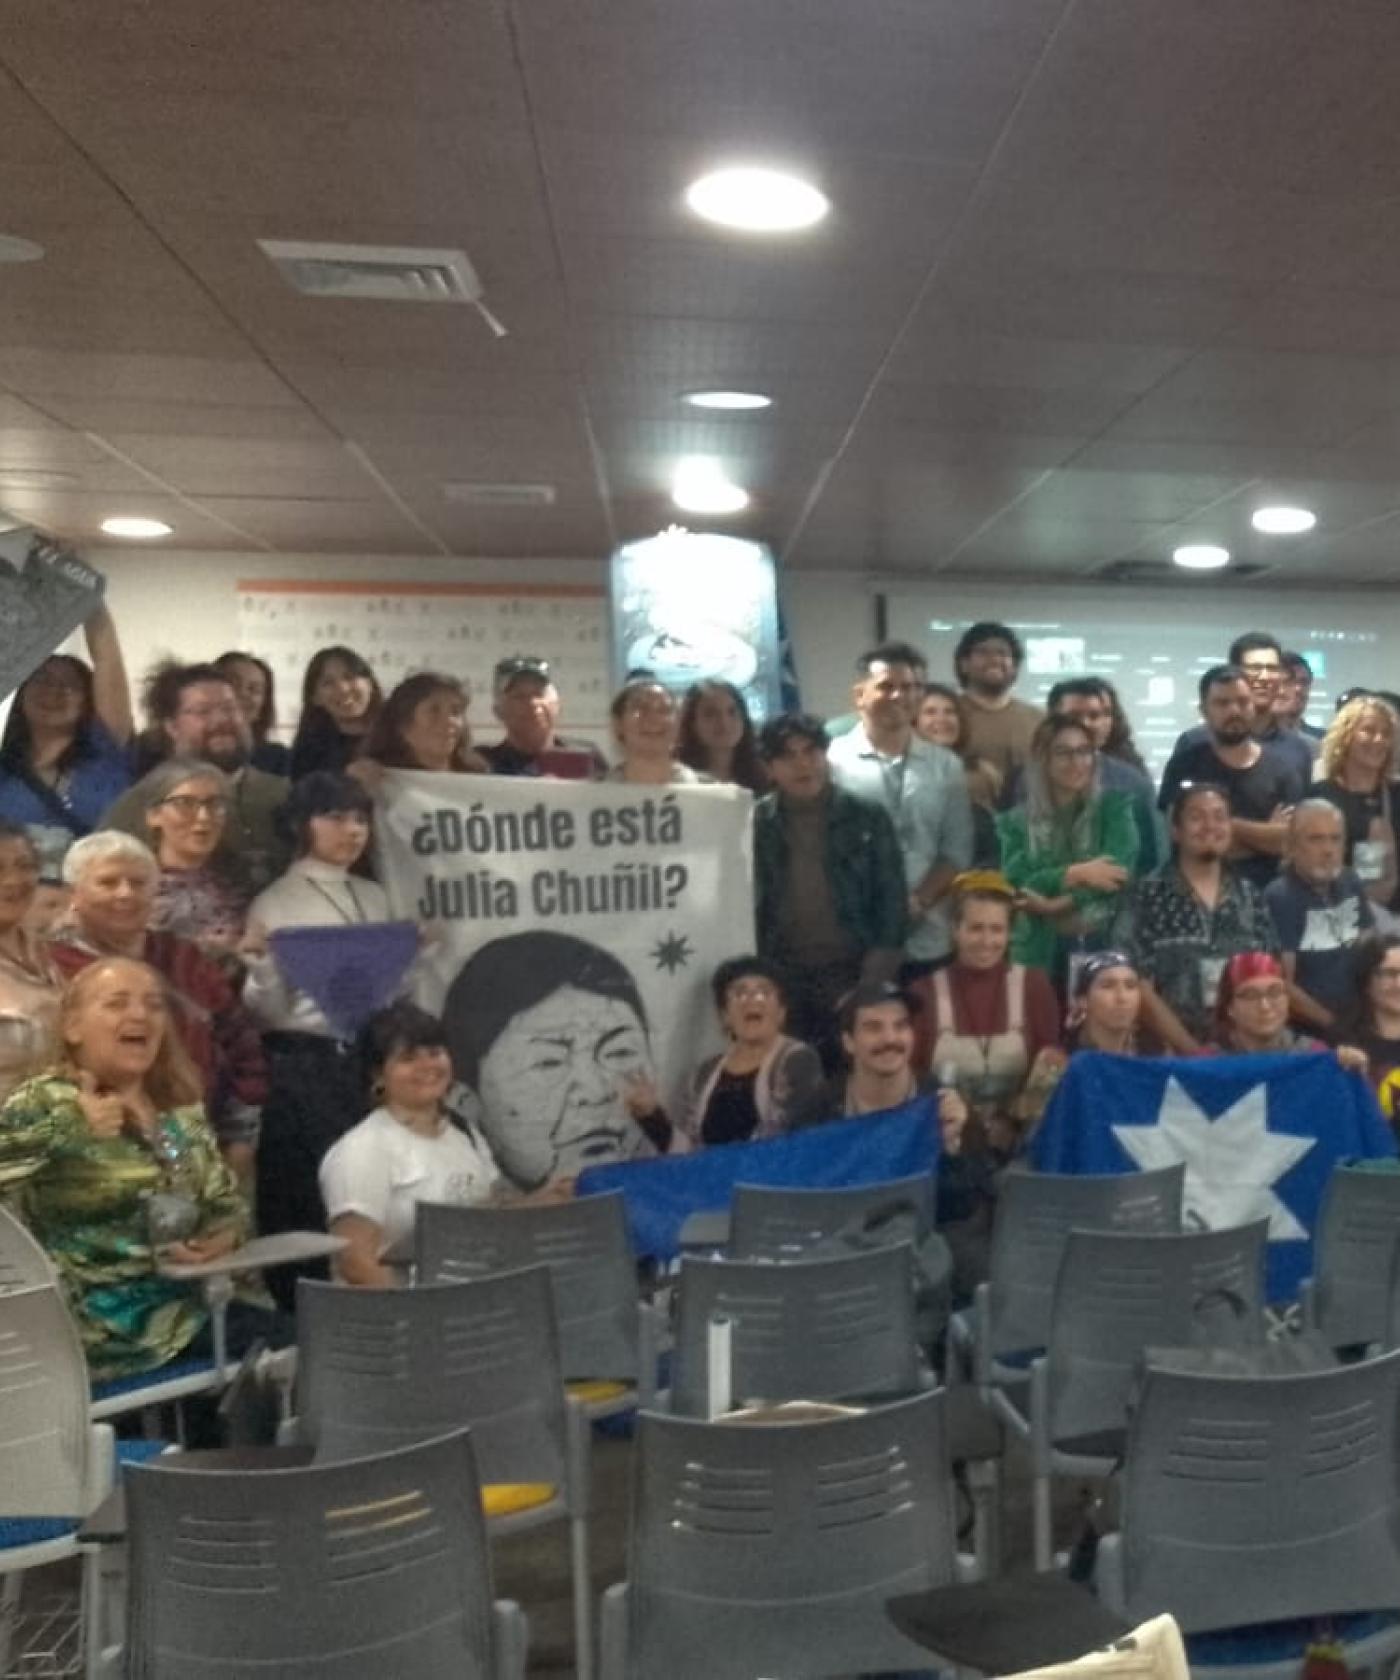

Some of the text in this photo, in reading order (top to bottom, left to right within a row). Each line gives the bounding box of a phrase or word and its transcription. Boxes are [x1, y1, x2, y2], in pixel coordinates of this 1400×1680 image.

[412, 794, 683, 855] ¿Dónde está
[417, 862, 689, 920] Julia Chuñil?
